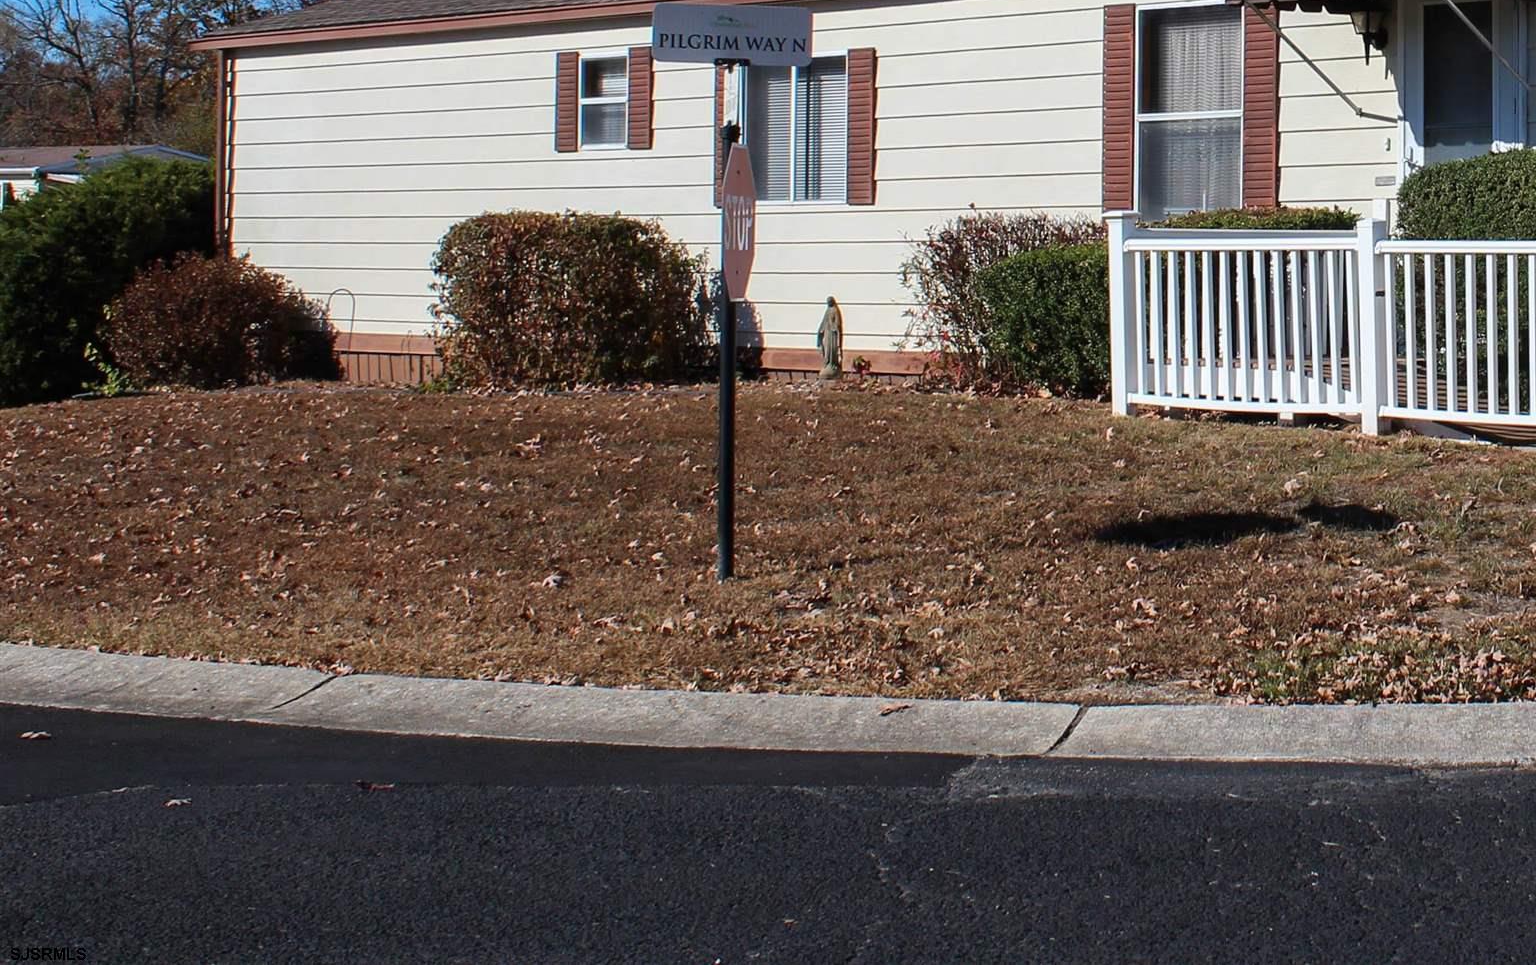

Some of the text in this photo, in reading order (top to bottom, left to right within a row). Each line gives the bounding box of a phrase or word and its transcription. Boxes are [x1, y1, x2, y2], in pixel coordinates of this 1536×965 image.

[659, 33, 807, 53] PILGRIM WAY N
[725, 195, 753, 250] STOP
